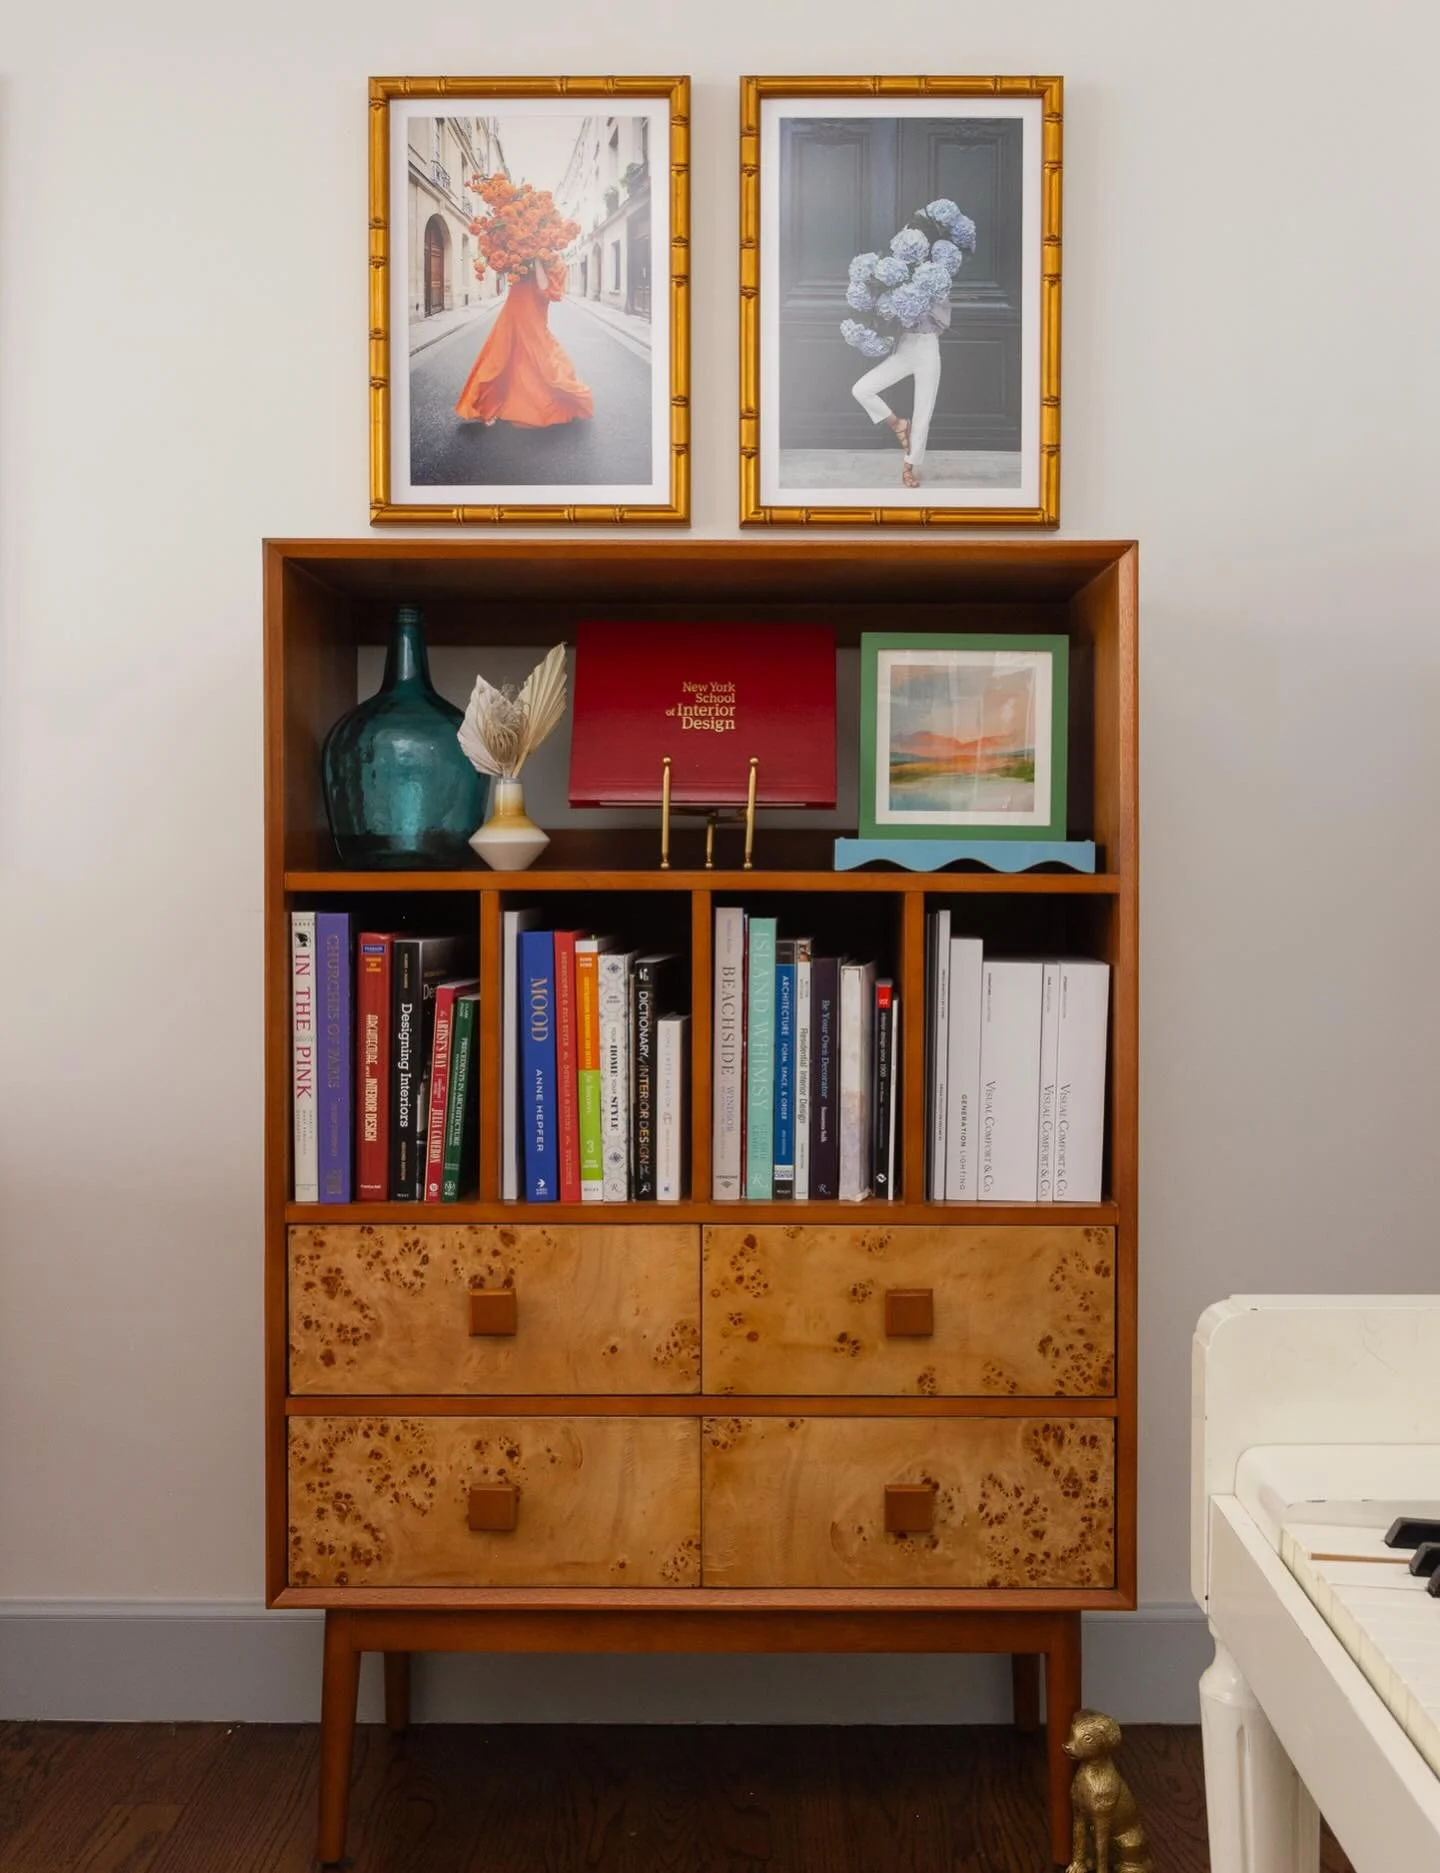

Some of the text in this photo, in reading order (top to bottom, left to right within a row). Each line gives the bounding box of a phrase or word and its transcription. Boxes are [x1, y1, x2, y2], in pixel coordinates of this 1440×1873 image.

[683, 682, 736, 692] New York
[696, 693, 735, 703] School
[665, 703, 736, 716] of Interior
[682, 716, 736, 732] Design
[531, 977, 549, 1041] MOOD
[639, 991, 649, 1057] DICTIONARY
[722, 967, 736, 1075] BEACHSIDE
[752, 933, 769, 1109] ISLAND WHIMSY
[781, 976, 789, 1036] ARCHITECTURE
[822, 1000, 830, 1010] Be
[822, 1013, 830, 1033] Your
[296, 954, 312, 1098] IN THE PINK
[366, 1015, 378, 1064] ARCHITECTURE
[398, 1003, 412, 1069] Designing
[435, 1053, 447, 1068] WAY
[459, 1038, 468, 1081] PRECEDENTS
[798, 1028, 809, 1123] Residential Interior Design
[821, 1057, 829, 1098] Decorator
[366, 1079, 378, 1112] INTERIOR
[400, 1073, 411, 1127] Interiors
[457, 1083, 465, 1091] IN
[640, 1066, 649, 1118] INTERIOR
[365, 1114, 377, 1141] DESIGN
[432, 1108, 443, 1127] JULIA
[453, 1093, 463, 1145] ARCHITECTURE
[536, 1069, 544, 1152] ANNE HEPFER
[430, 1130, 442, 1163] CAMERON
[640, 1121, 649, 1163] DESIGN
[984, 1165, 992, 1173] &
[1040, 1169, 1049, 1178] &
[1057, 1169, 1066, 1177] &
